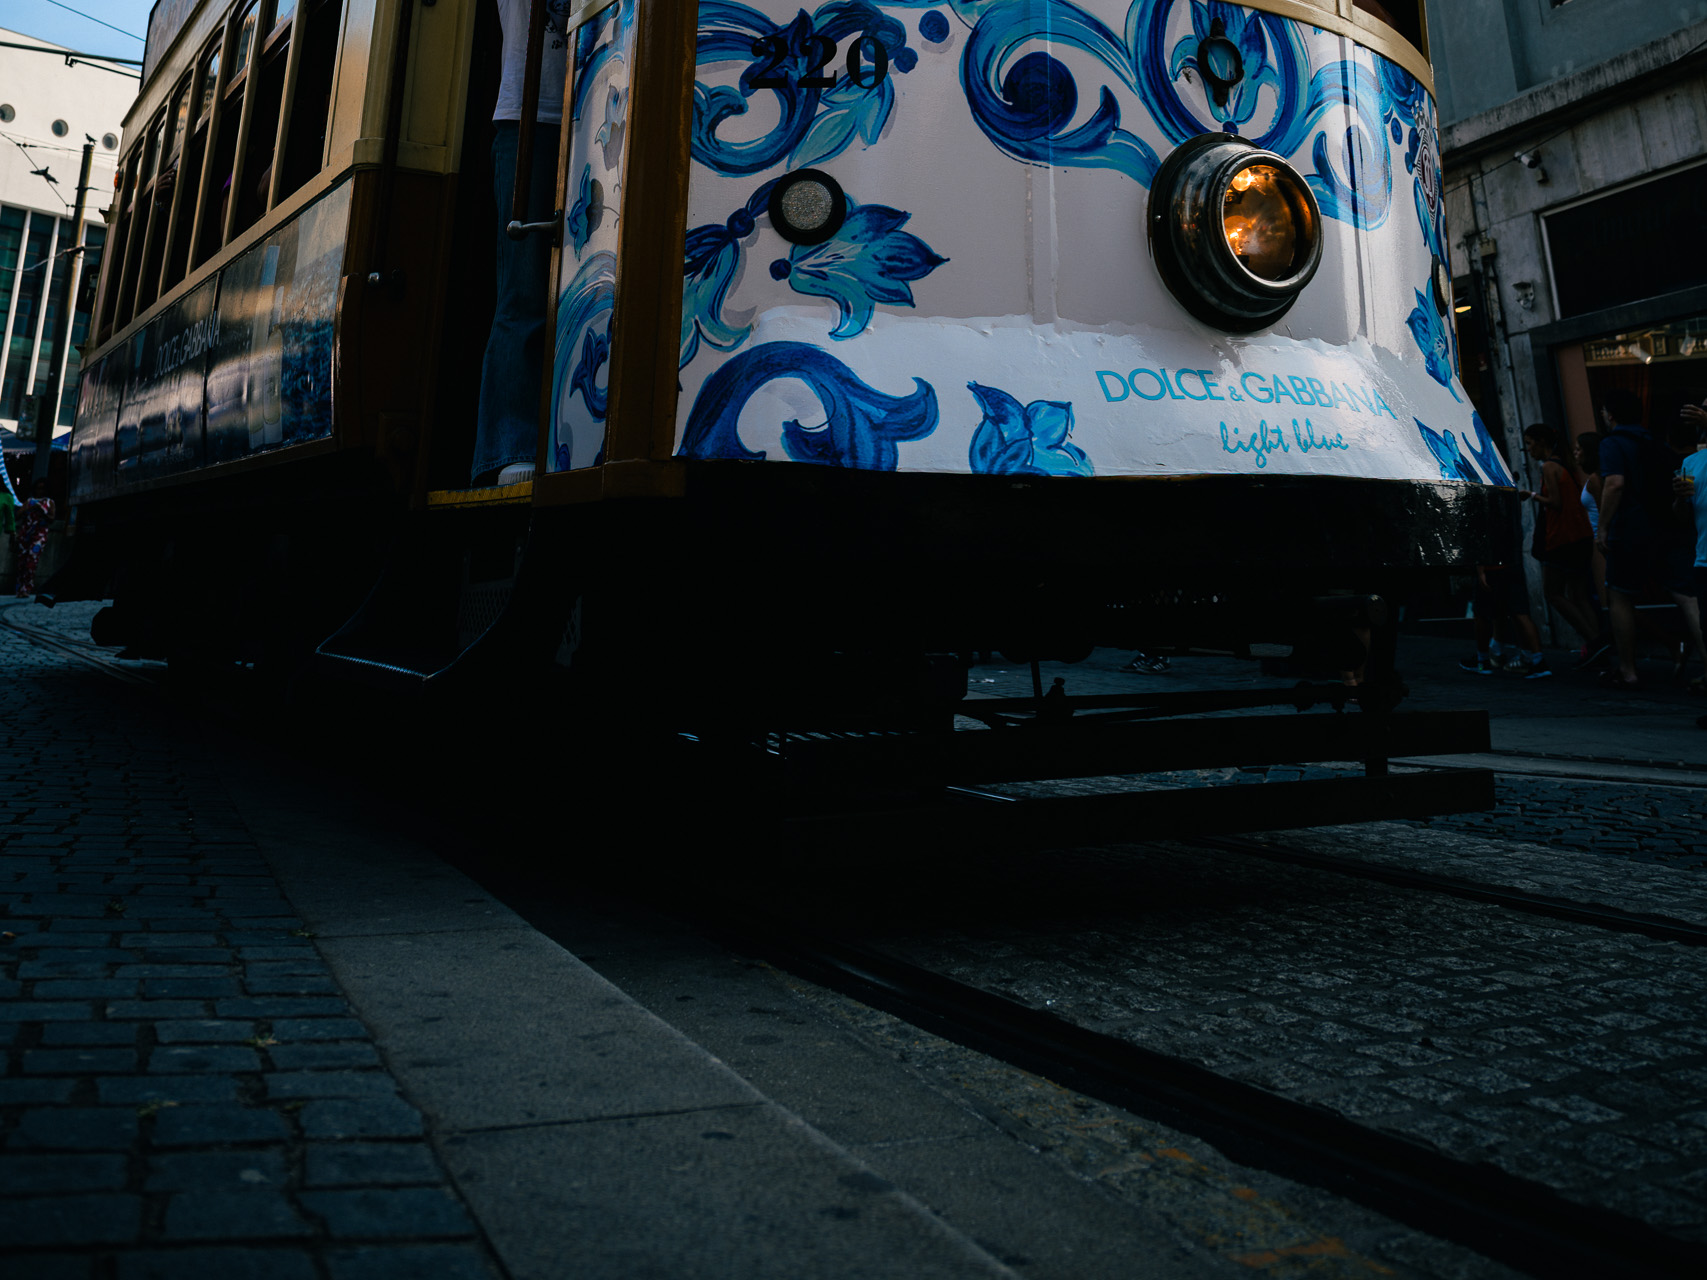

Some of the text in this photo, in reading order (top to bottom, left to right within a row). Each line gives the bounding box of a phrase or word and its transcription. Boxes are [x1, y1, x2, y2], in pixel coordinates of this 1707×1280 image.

[749, 35, 889, 89] 220
[1096, 368, 1399, 420] DOLCE & GABBANA
[1219, 418, 1349, 469] light blue
